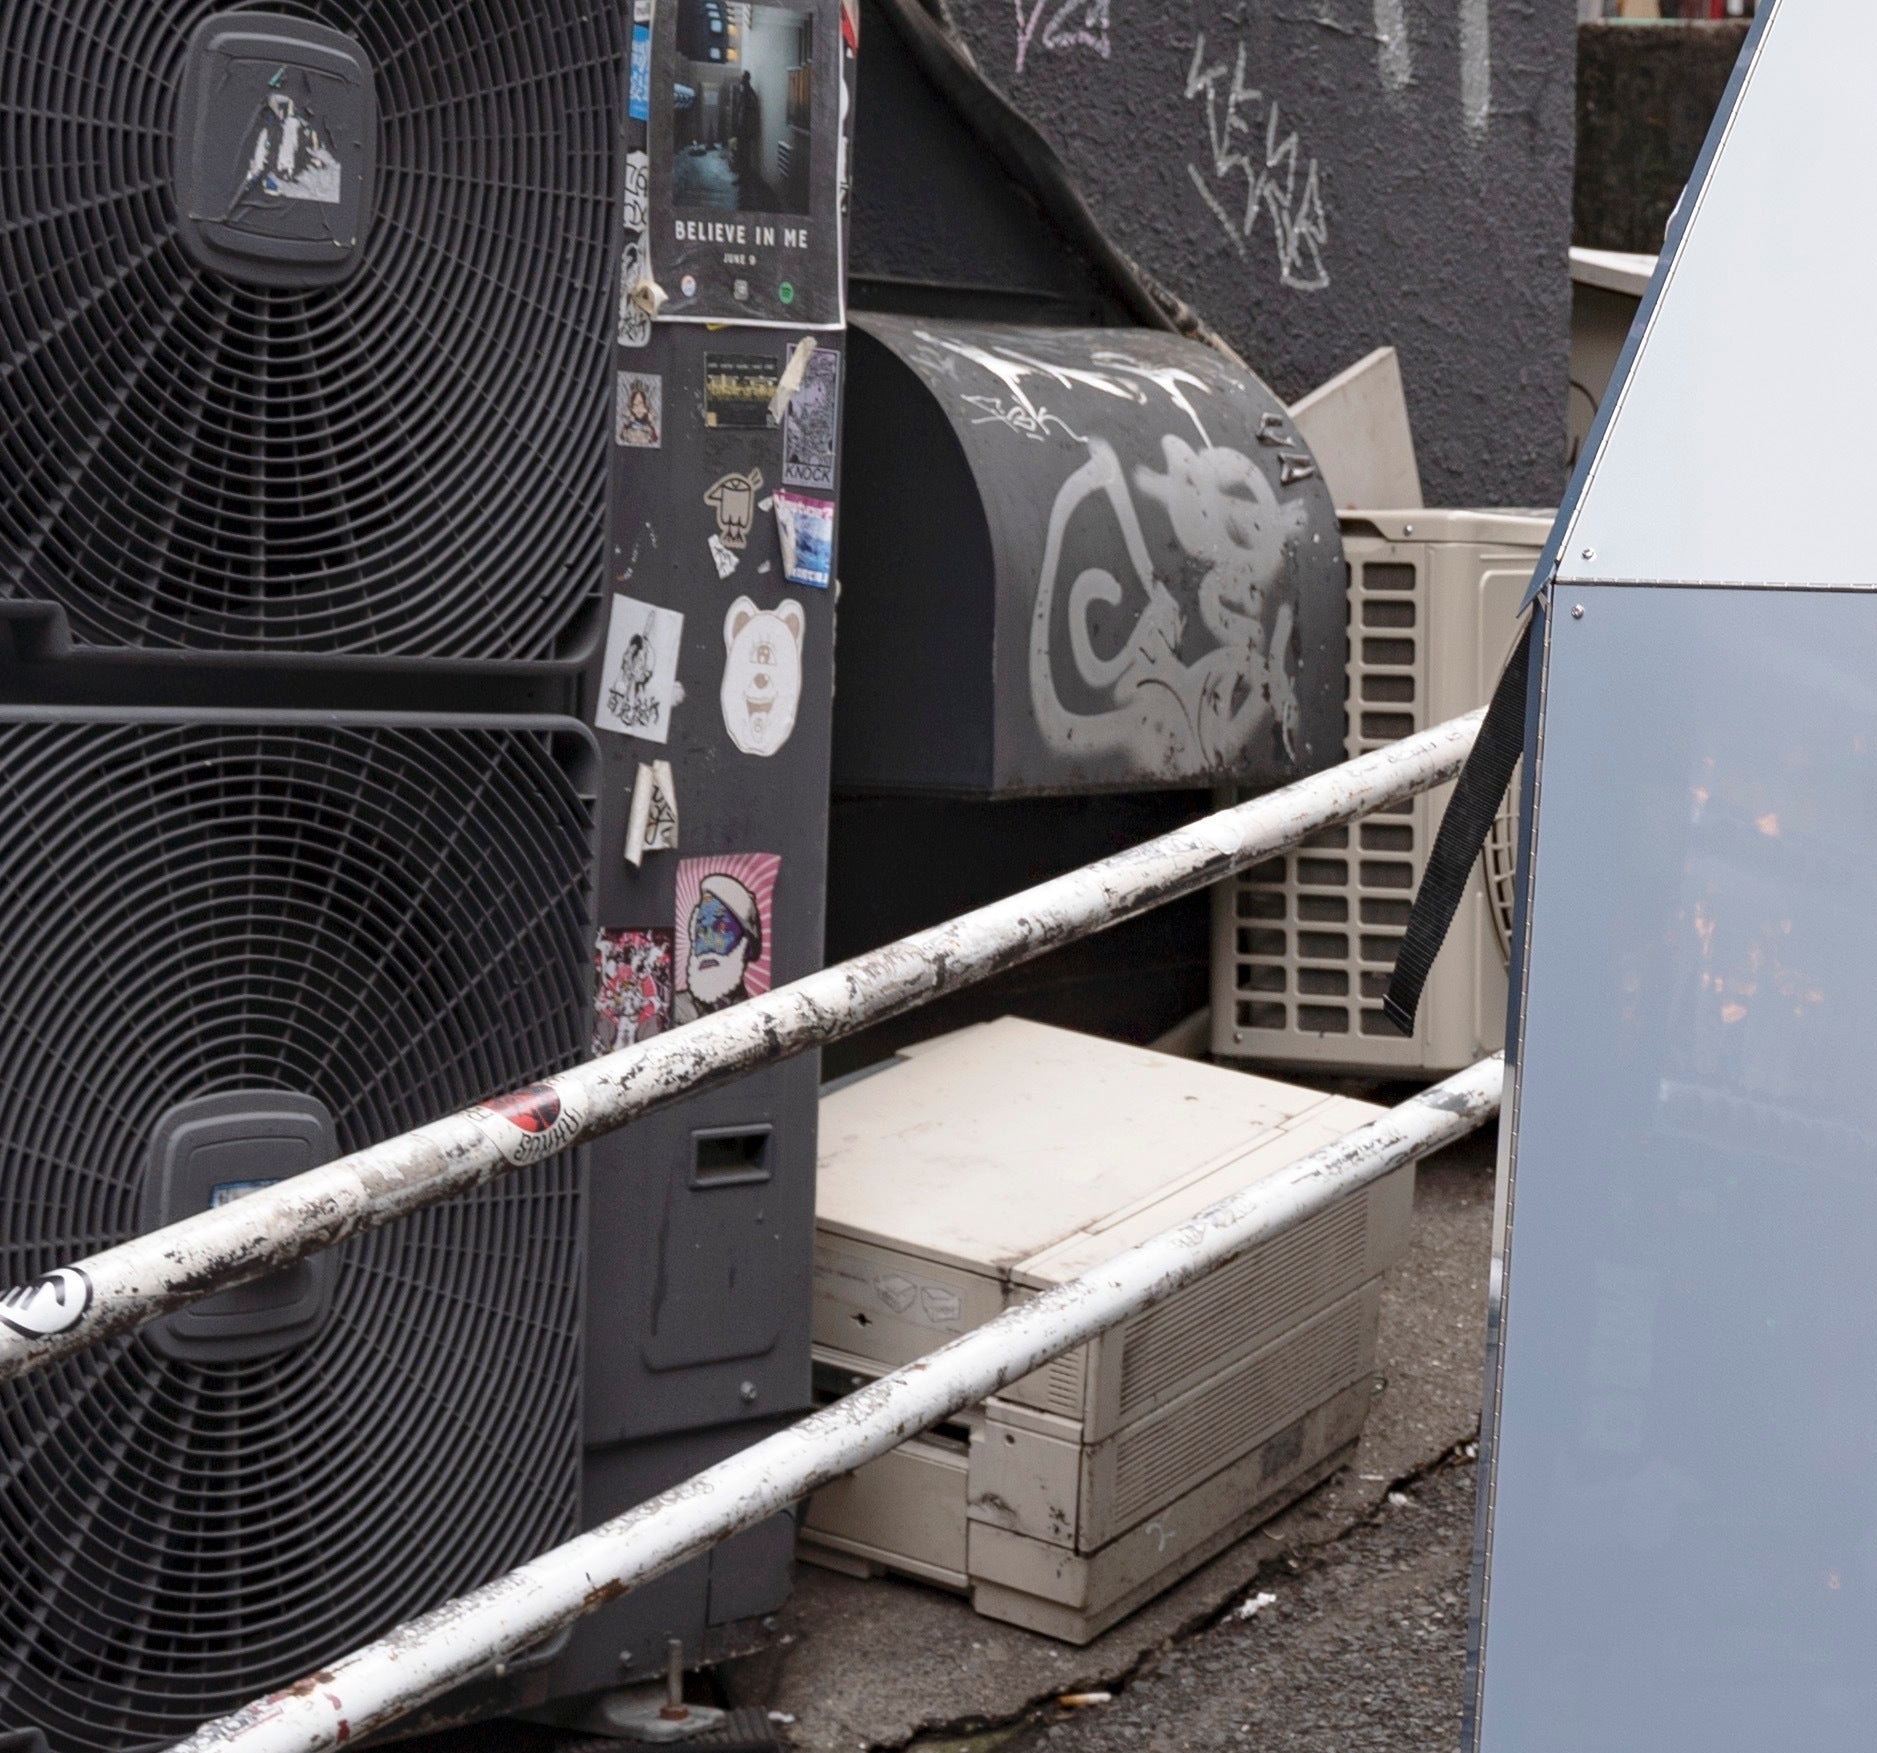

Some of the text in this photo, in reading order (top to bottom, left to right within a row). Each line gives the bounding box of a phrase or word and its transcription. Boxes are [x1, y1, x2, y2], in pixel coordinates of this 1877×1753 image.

[675, 220, 809, 249] BELIEVE IN ME
[723, 252, 746, 266] JUNE
[785, 465, 831, 483] KNOCK
